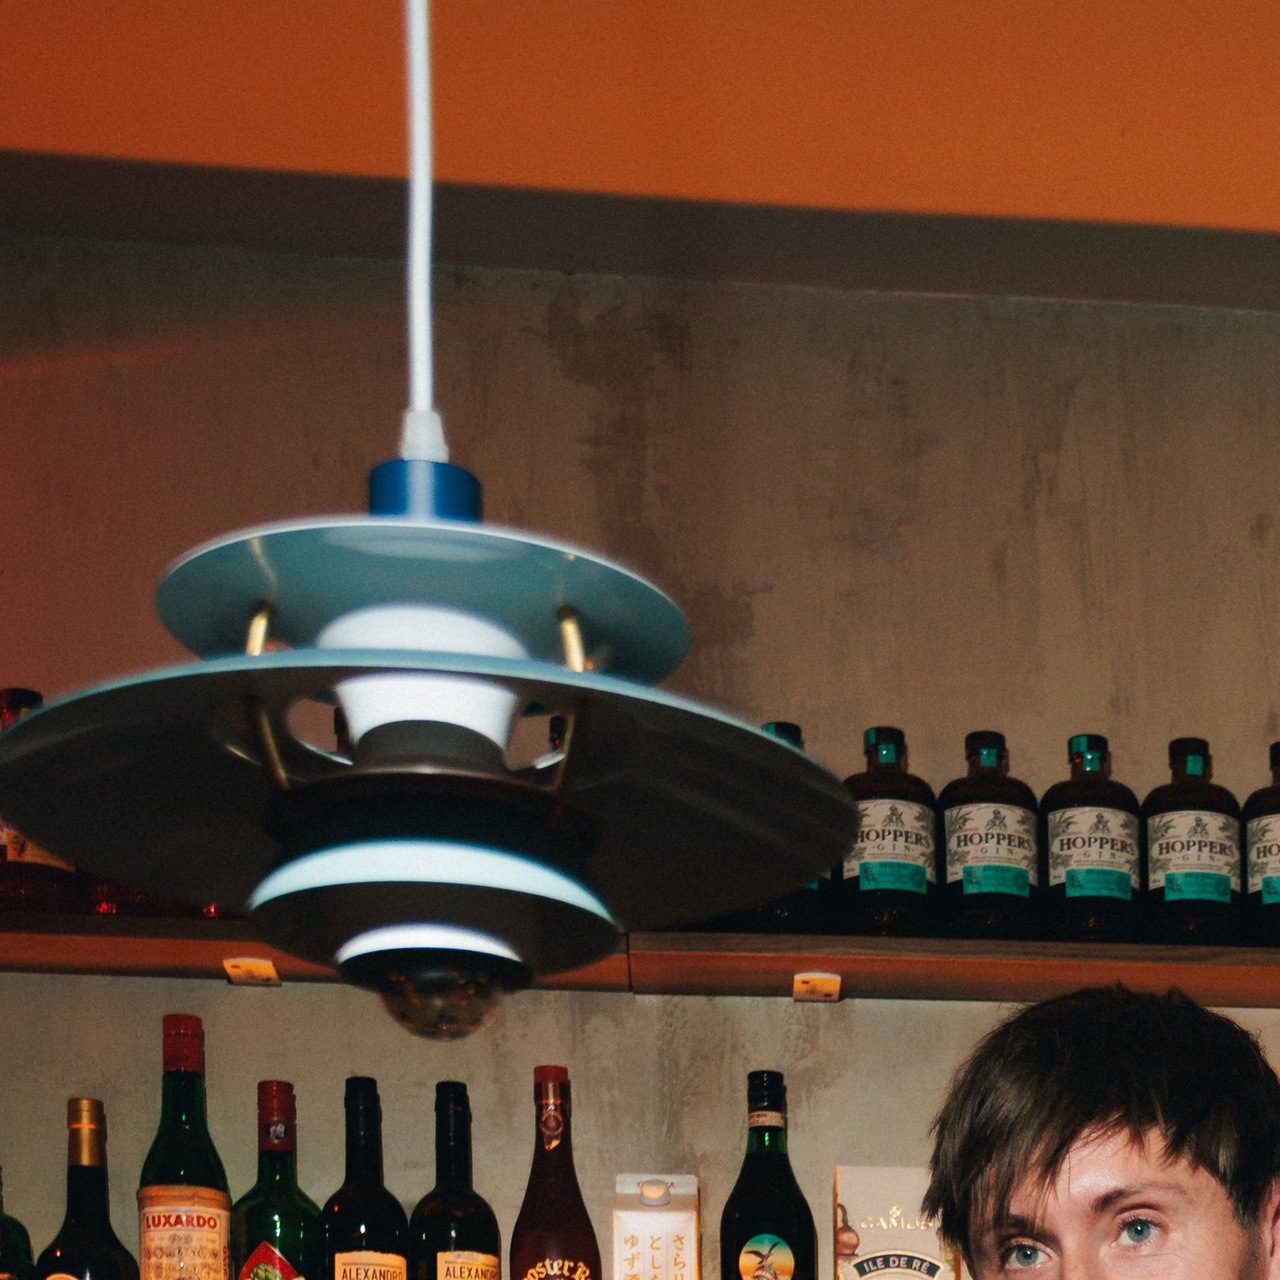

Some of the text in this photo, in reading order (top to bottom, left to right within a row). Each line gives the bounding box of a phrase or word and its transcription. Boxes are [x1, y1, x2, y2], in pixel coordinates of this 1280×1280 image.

[957, 832, 1032, 852] HOPPERS
[1060, 836, 1135, 856] HOPPERS
[1158, 840, 1235, 857] HOPPERS
[145, 1214, 217, 1229] LUXARDO
[863, 1257, 884, 1274] ILE
[889, 1256, 907, 1268] DE
